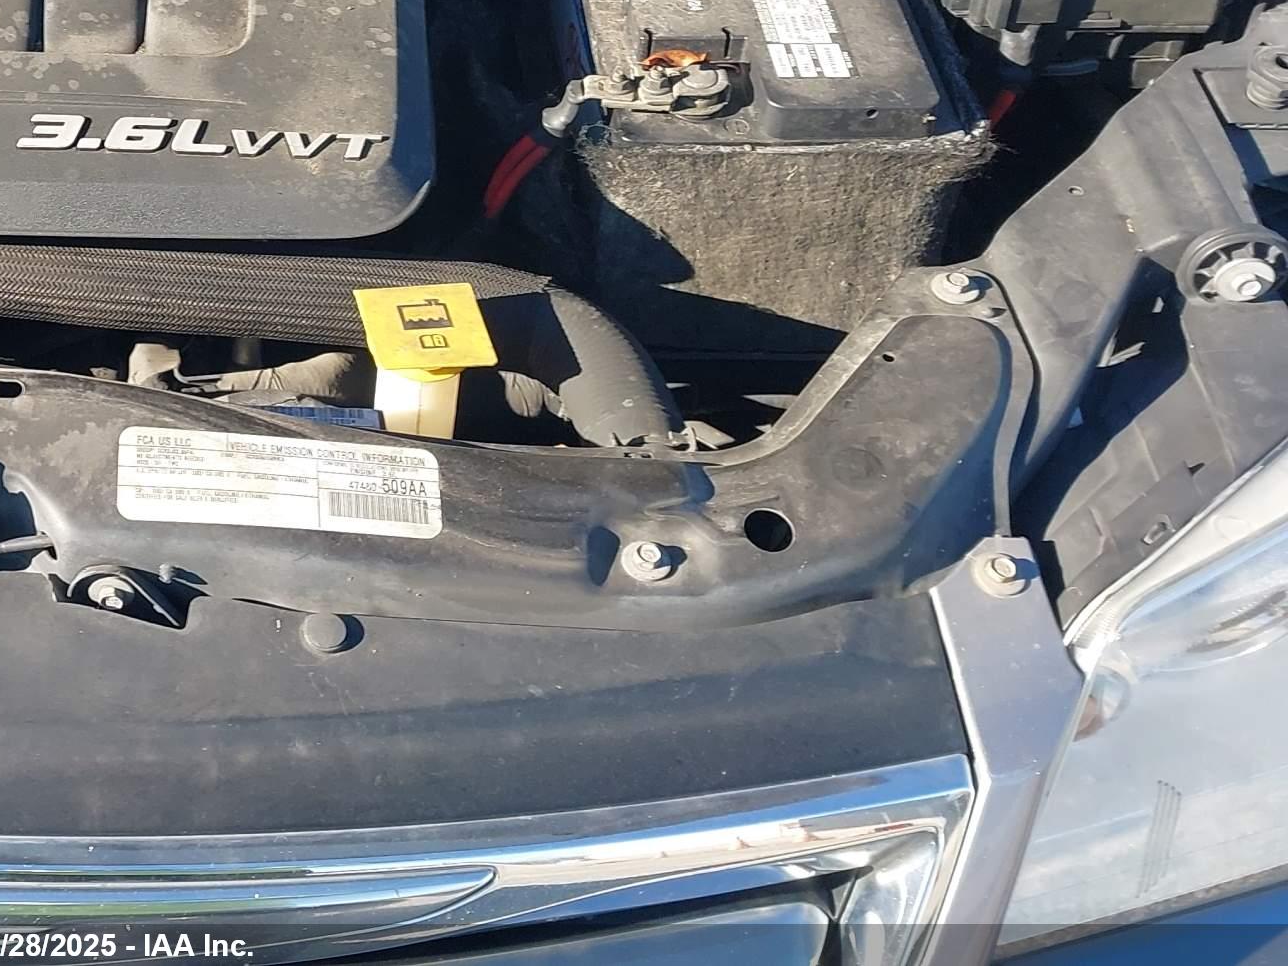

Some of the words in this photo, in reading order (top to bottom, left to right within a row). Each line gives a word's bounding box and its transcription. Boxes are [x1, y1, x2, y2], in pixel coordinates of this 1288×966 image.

[136, 434, 155, 445] FCA
[158, 435, 171, 445] US
[173, 437, 192, 447] LLC
[228, 441, 267, 453] VEHICLE
[270, 444, 313, 457] EMISSION
[316, 448, 359, 461] CONTROL
[360, 452, 426, 467] INFORMATION
